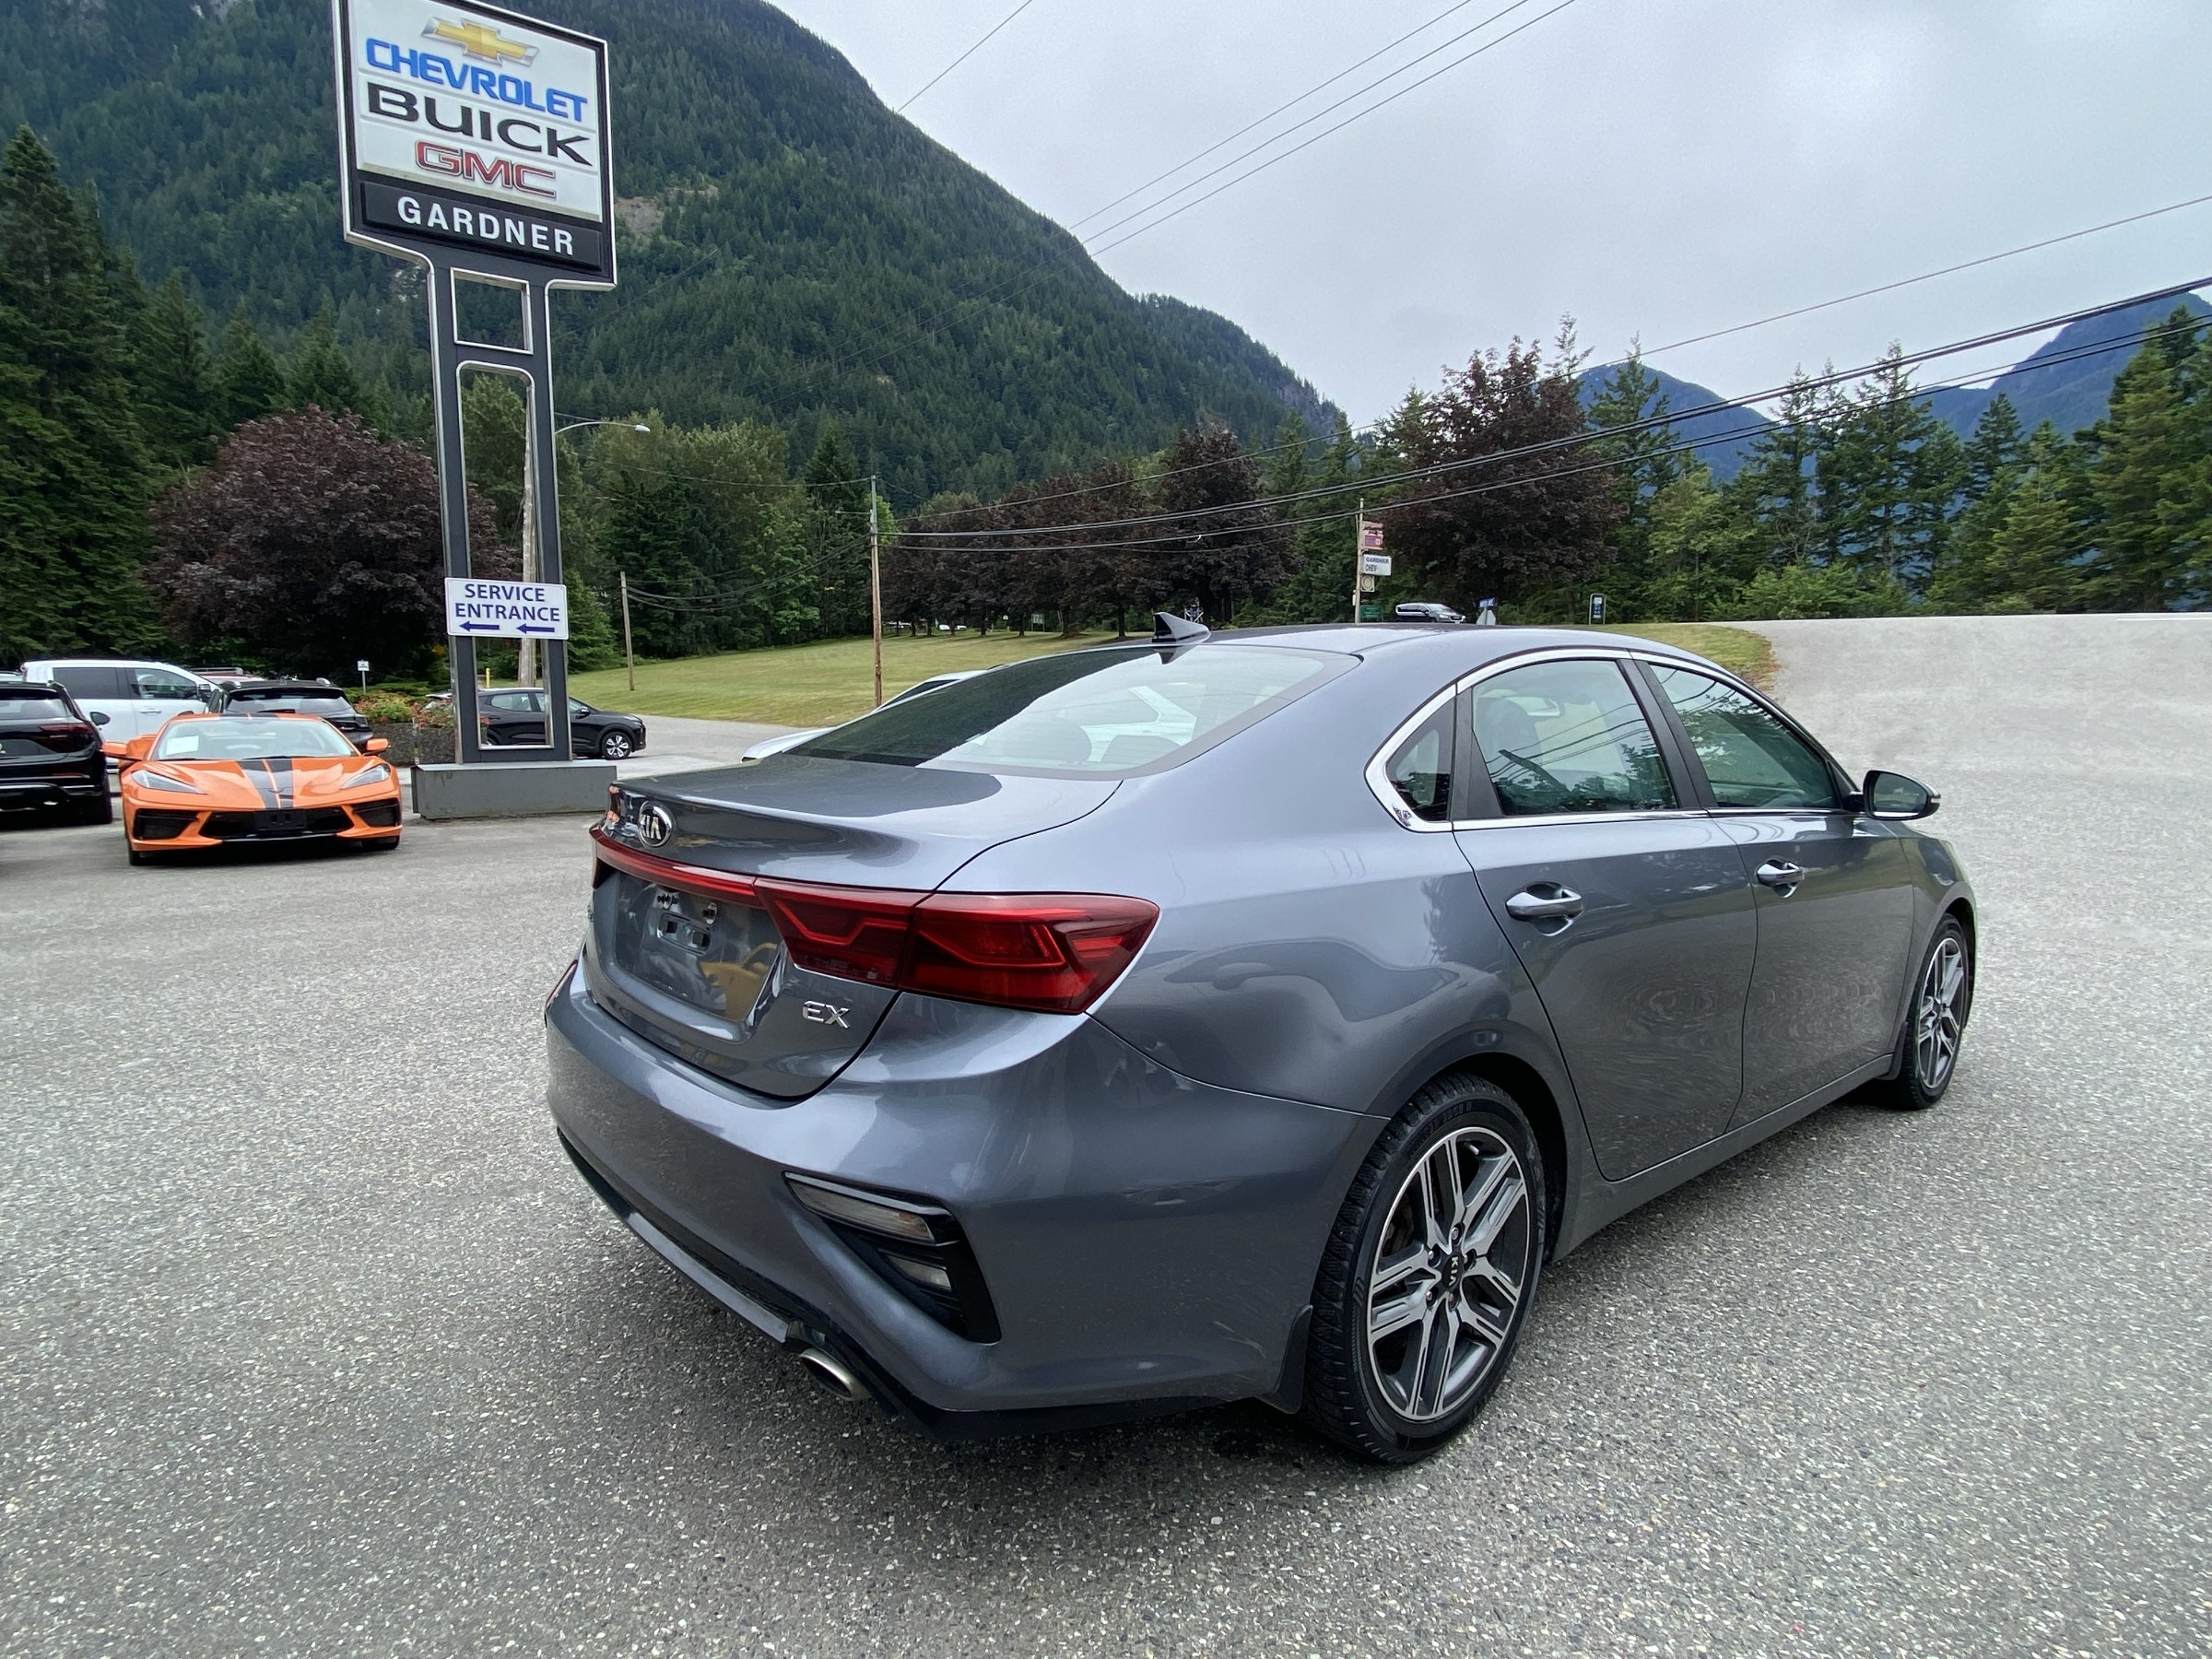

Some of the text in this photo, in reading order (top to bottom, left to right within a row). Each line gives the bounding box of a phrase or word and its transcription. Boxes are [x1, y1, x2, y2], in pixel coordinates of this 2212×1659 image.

[366, 38, 588, 122] CHEVROLET
[367, 82, 594, 168] BUICK
[416, 140, 557, 199] GMC
[397, 196, 574, 256] GARDNER
[454, 603, 560, 622] ENTRANCE
[465, 583, 546, 603] SERVICE
[802, 1000, 850, 1029] EX
[1449, 1256, 1459, 1287] KIA
